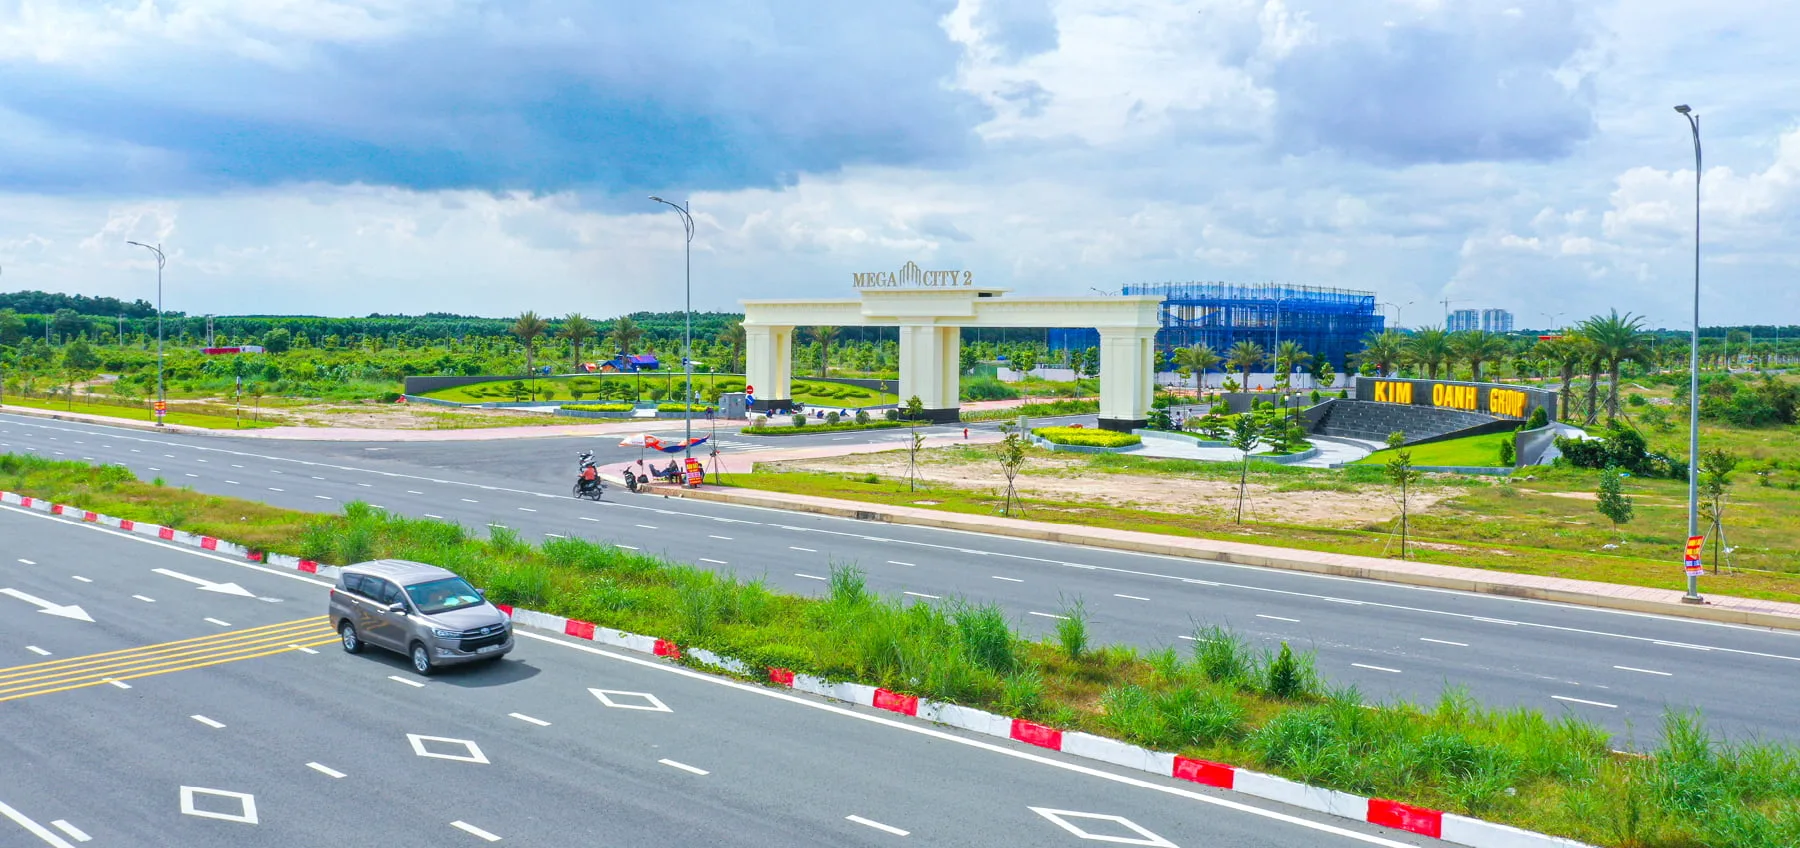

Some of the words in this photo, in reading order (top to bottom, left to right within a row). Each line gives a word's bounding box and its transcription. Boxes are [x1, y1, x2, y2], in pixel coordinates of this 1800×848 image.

[853, 272, 897, 287] MEGA
[923, 270, 960, 286] CITY
[963, 270, 972, 286] 2
[1375, 381, 1412, 404] KIM
[1433, 384, 1478, 410] OANH
[1490, 388, 1526, 418] GROUP
